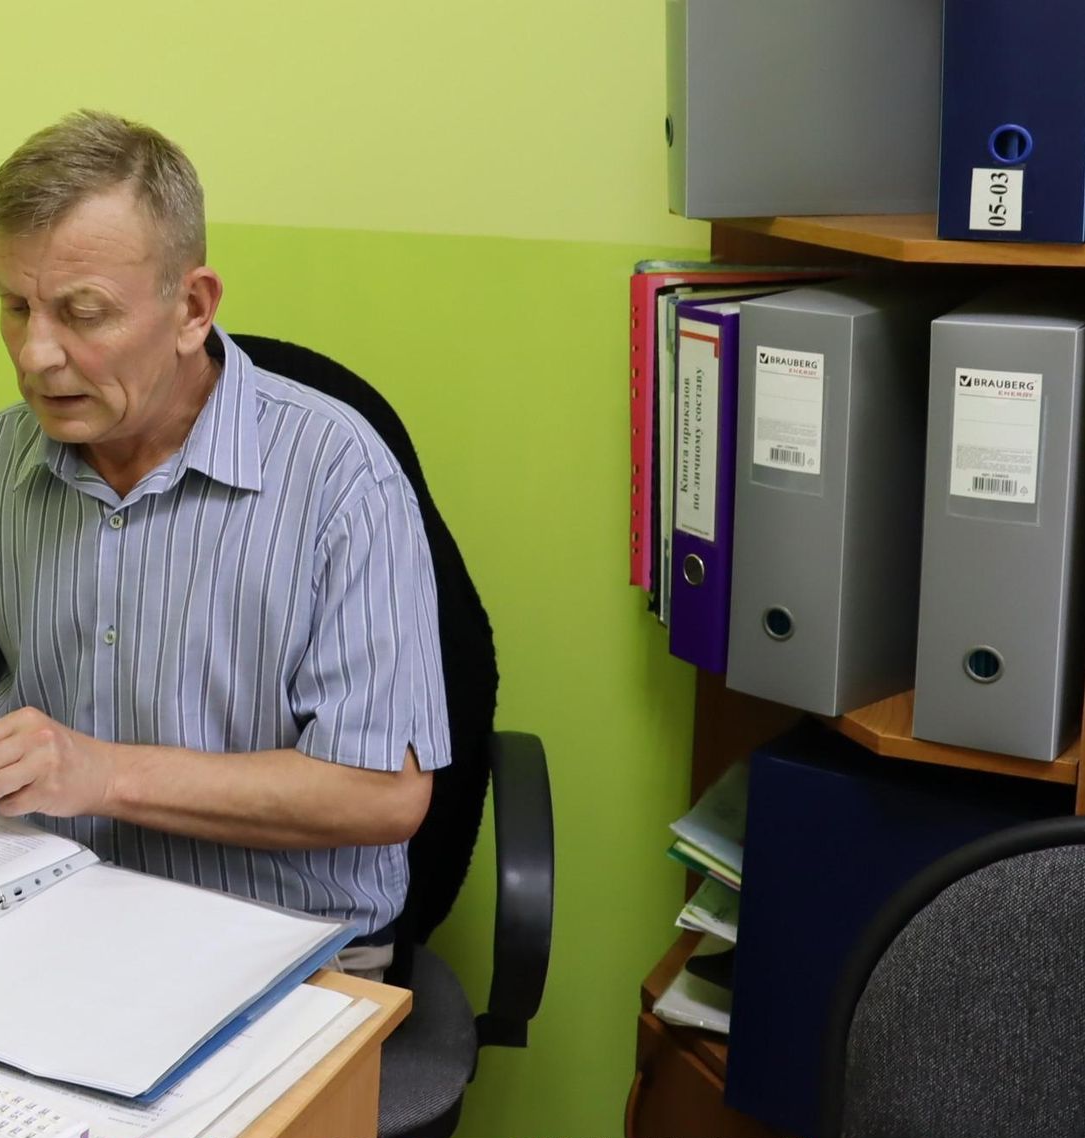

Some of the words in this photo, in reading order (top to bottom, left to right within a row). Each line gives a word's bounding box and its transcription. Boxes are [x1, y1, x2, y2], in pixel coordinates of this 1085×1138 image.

[988, 172, 1008, 227] 05-03
[770, 356, 818, 369] BRAUBERG
[974, 378, 1034, 390] BRAUBERG
[683, 378, 692, 445] приказов
[696, 368, 704, 422] составу
[680, 454, 689, 493] Книга
[694, 426, 704, 490] личному
[693, 493, 700, 510] по
